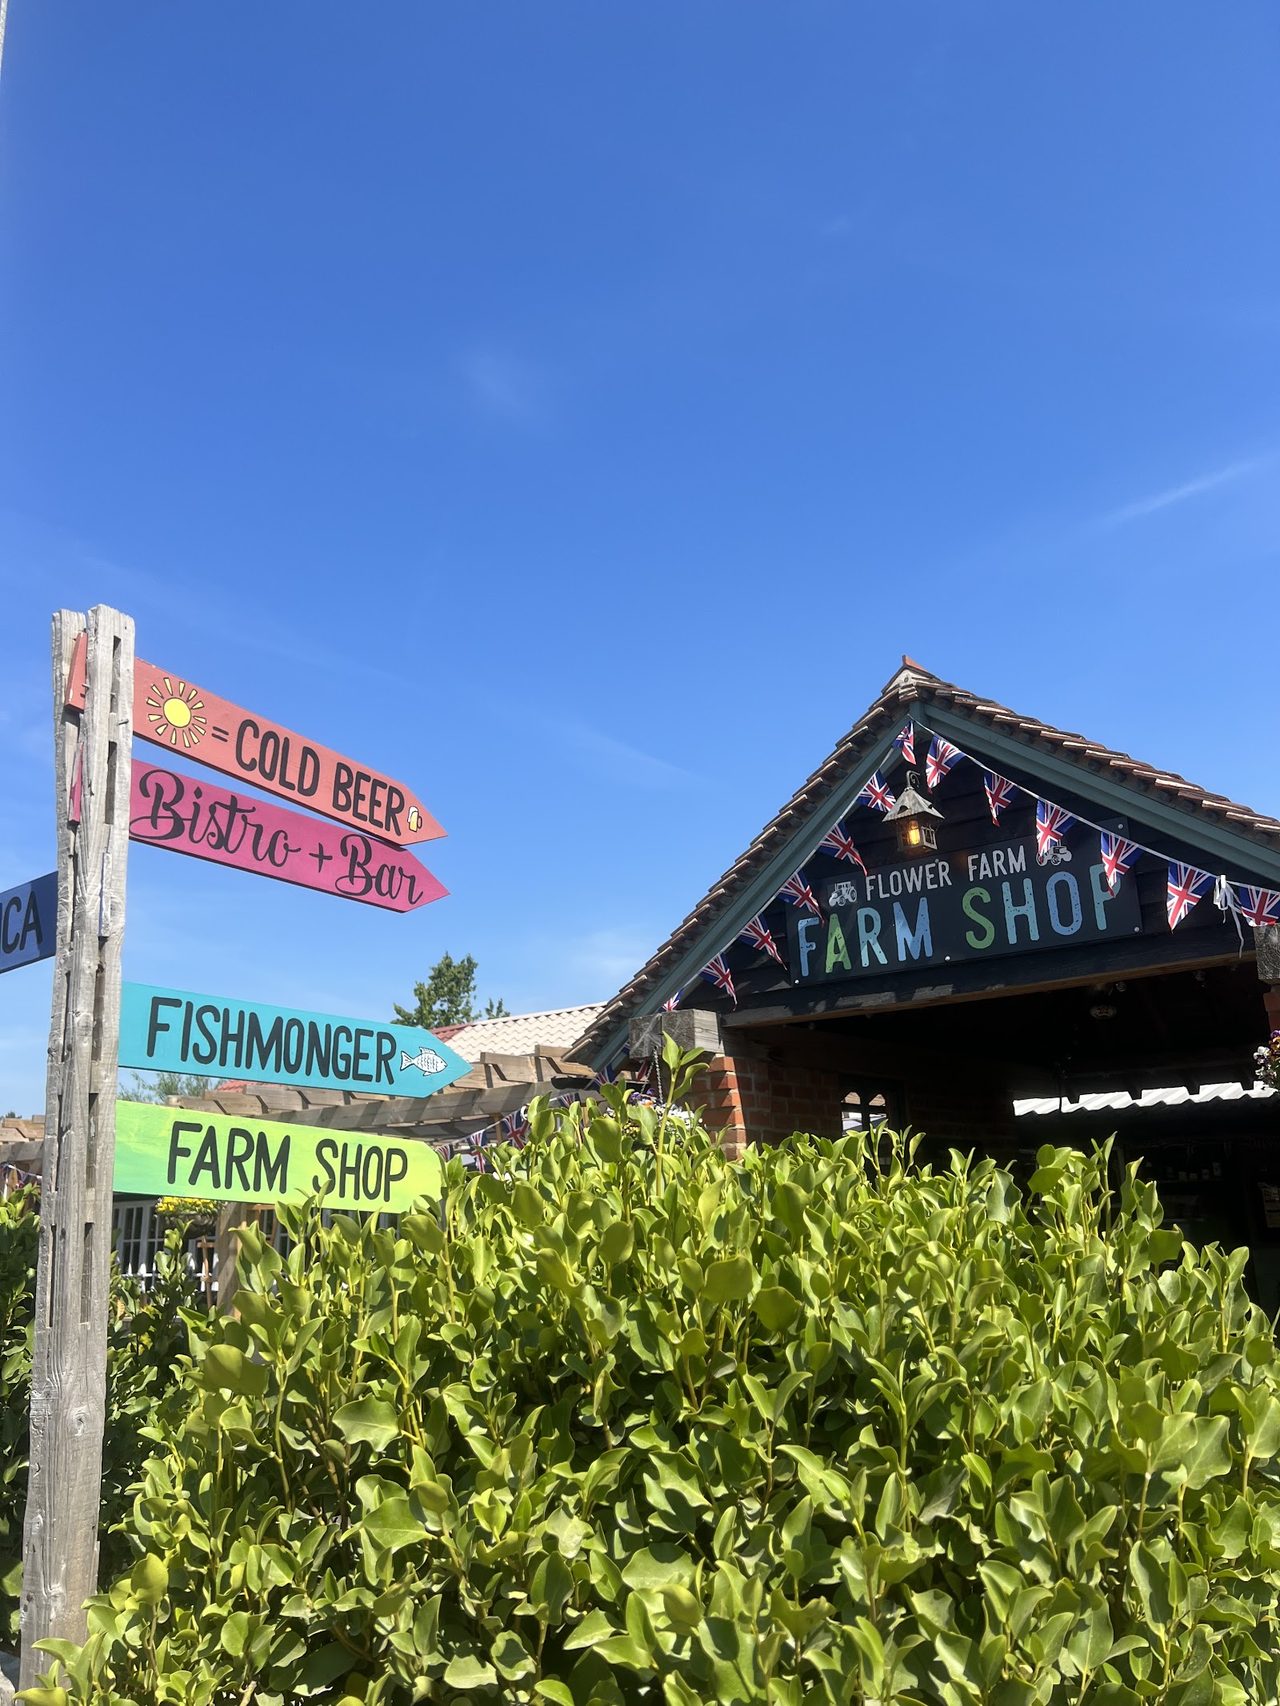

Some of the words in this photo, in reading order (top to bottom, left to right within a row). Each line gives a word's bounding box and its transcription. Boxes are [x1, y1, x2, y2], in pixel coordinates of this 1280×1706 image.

[235, 719, 320, 797] COLD
[332, 762, 404, 836] BEER
[129, 769, 301, 867] Bistro
[309, 842, 333, 873] +
[335, 834, 423, 905] Bar
[865, 858, 952, 902] FLOWER
[967, 844, 1027, 882] FARM
[797, 896, 933, 977] FARM
[961, 863, 1120, 949] SHOP
[146, 996, 397, 1085] FISHMONGER
[167, 1121, 291, 1194] FARM
[312, 1138, 408, 1202] SHOP
